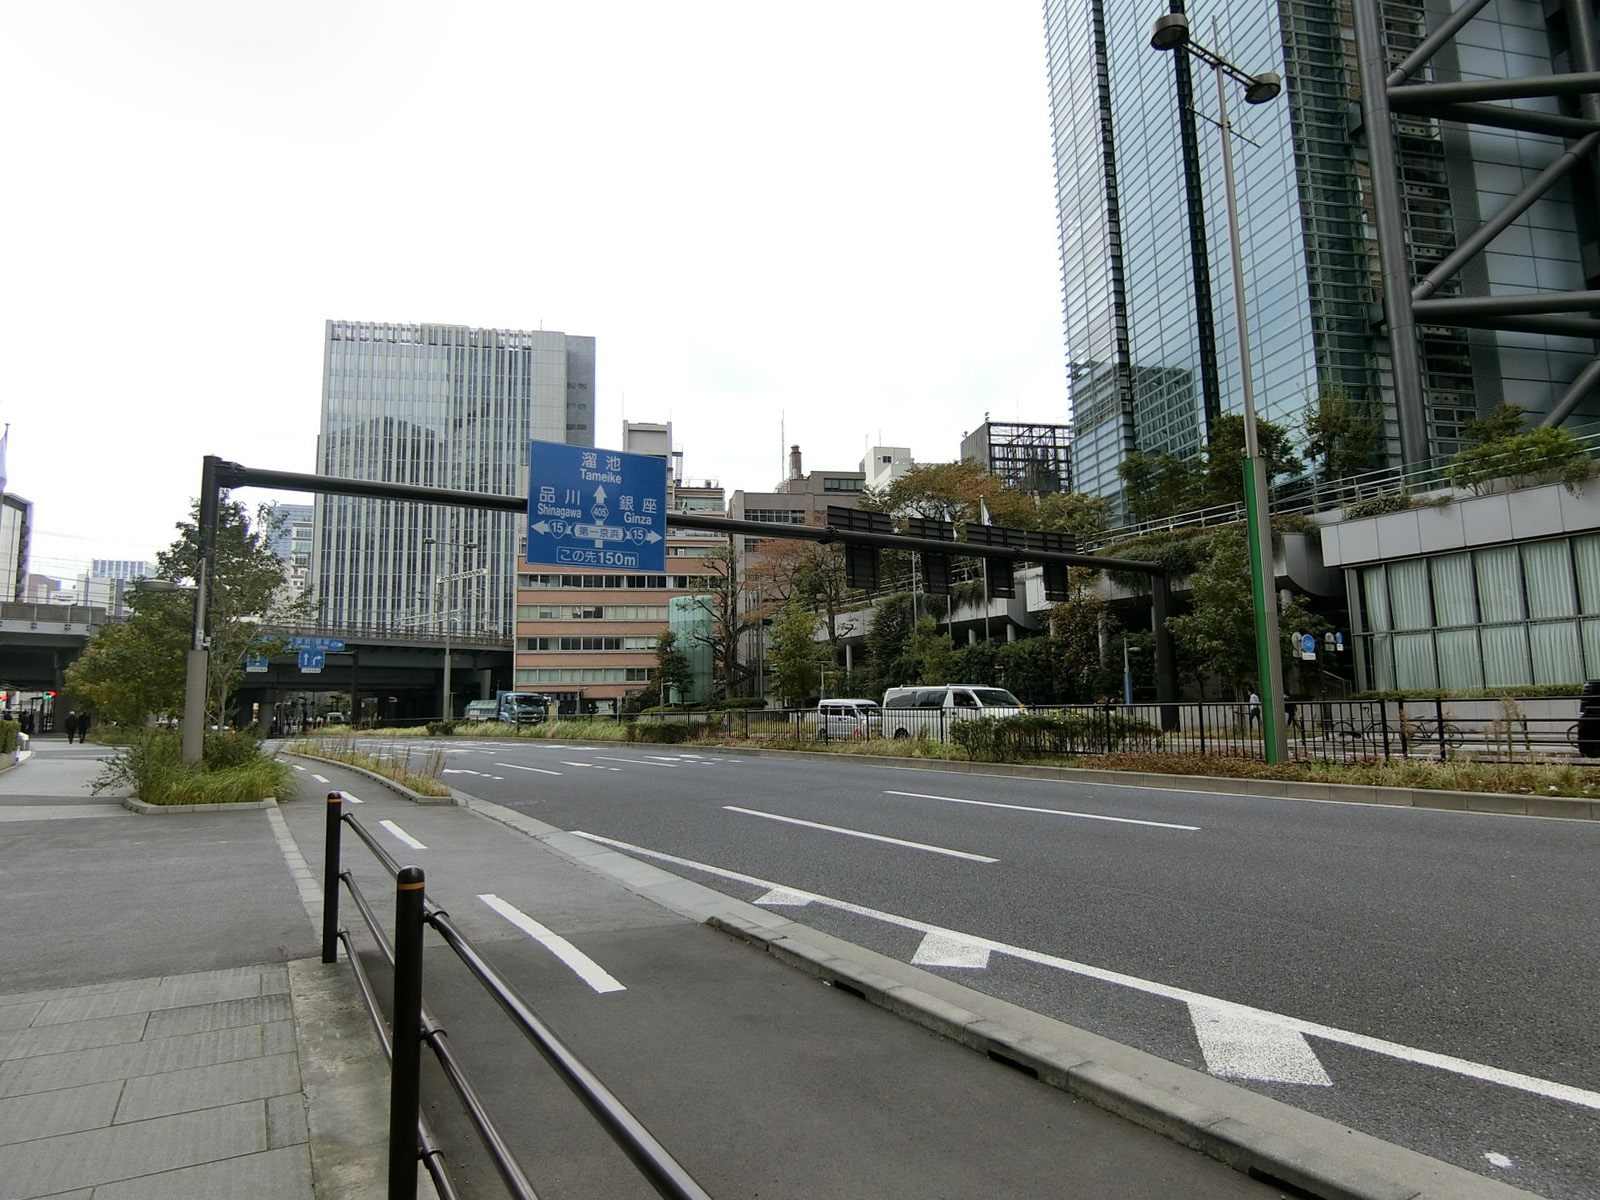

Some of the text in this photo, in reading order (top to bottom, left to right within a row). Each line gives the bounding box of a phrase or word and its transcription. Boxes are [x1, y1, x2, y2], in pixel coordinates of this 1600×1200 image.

[581, 452, 621, 472] 溜池
[580, 468, 622, 484] Tameike
[539, 486, 580, 506] 品川
[537, 503, 582, 519] Shinagawa
[619, 495, 657, 514] 銀座
[593, 508, 607, 517] 405
[624, 512, 652, 525] Ginza
[551, 522, 563, 533] 15
[578, 526, 620, 539] 第一京浜
[633, 529, 644, 540] 15
